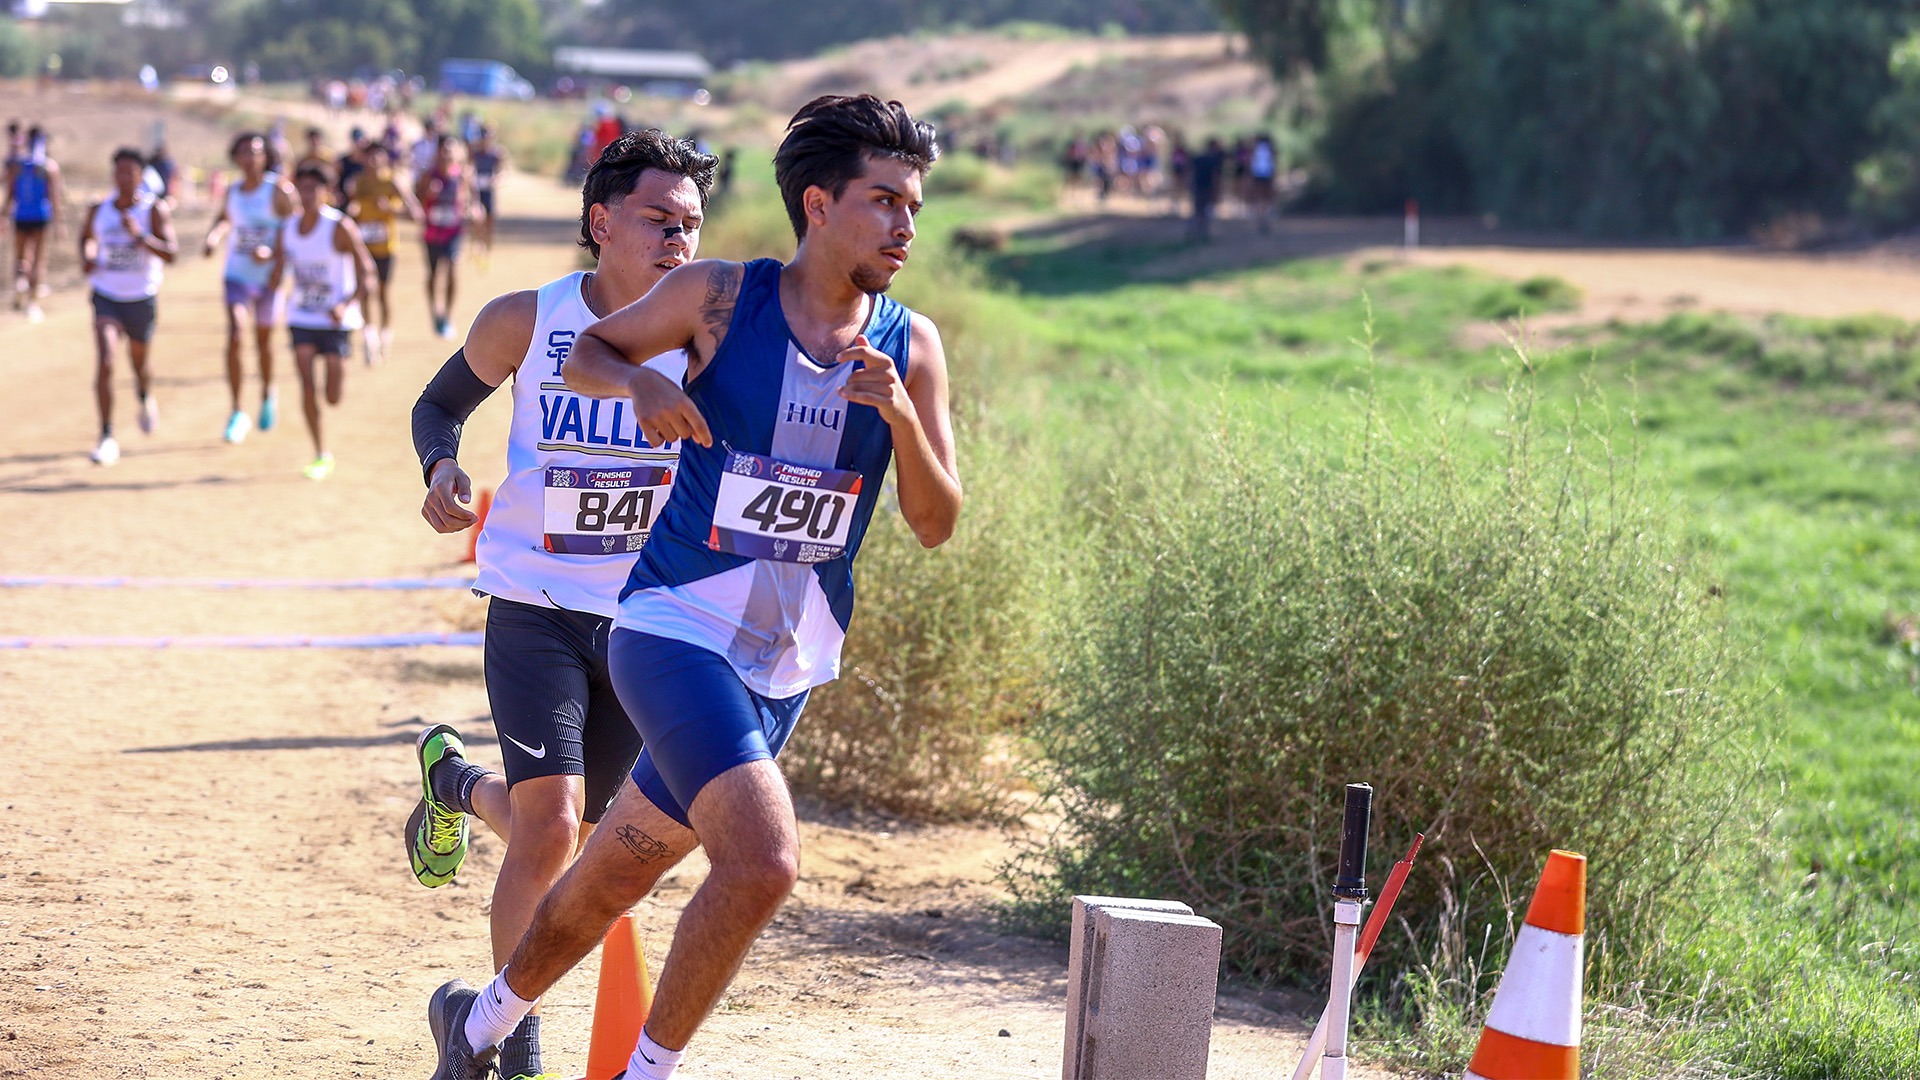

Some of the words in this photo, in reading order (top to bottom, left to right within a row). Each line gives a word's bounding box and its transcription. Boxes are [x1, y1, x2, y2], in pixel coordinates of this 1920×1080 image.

[540, 395, 671, 450] VALL
[785, 402, 841, 431] HIU
[597, 471, 632, 479] FINISHED
[778, 474, 818, 487] RESULTS
[782, 464, 822, 478] FINISHED
[594, 480, 630, 488] RESULTS
[576, 490, 653, 531] 841
[742, 485, 845, 539] 490
